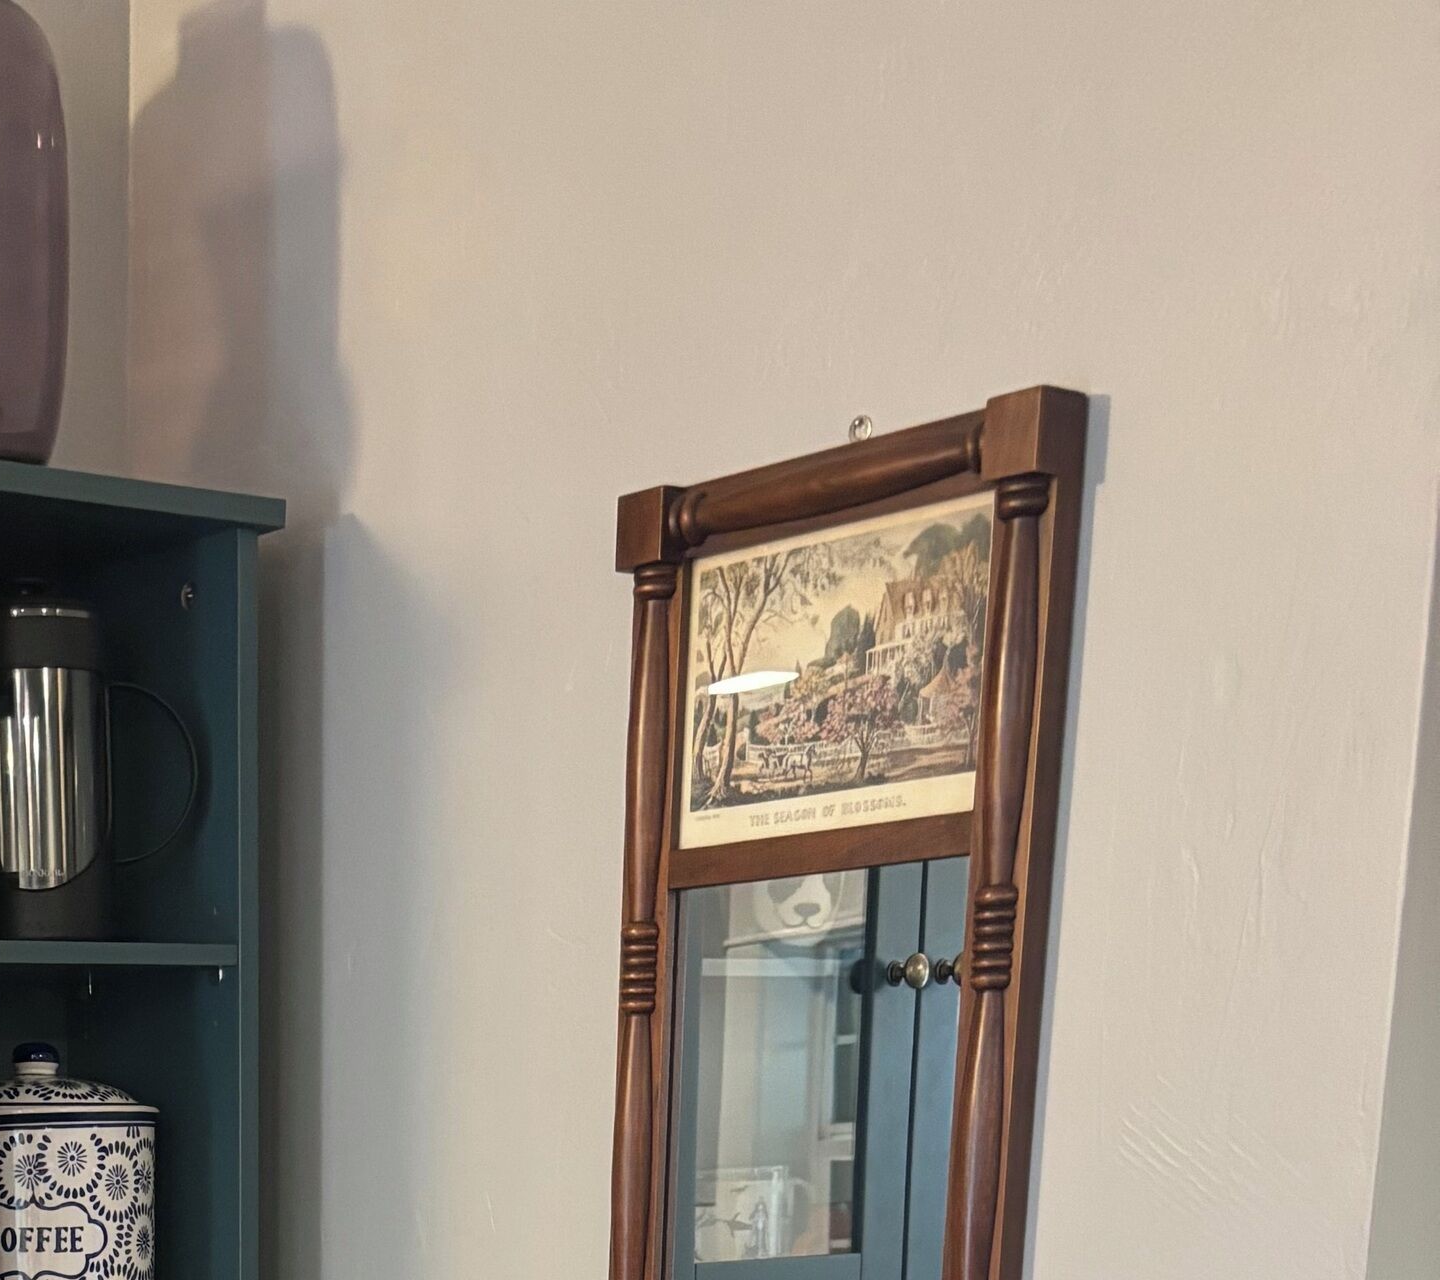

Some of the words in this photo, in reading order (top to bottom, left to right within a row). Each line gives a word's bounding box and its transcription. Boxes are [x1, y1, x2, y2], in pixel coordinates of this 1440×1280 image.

[749, 814, 770, 828] THE
[773, 807, 816, 826] SEASON
[822, 803, 836, 818] OF
